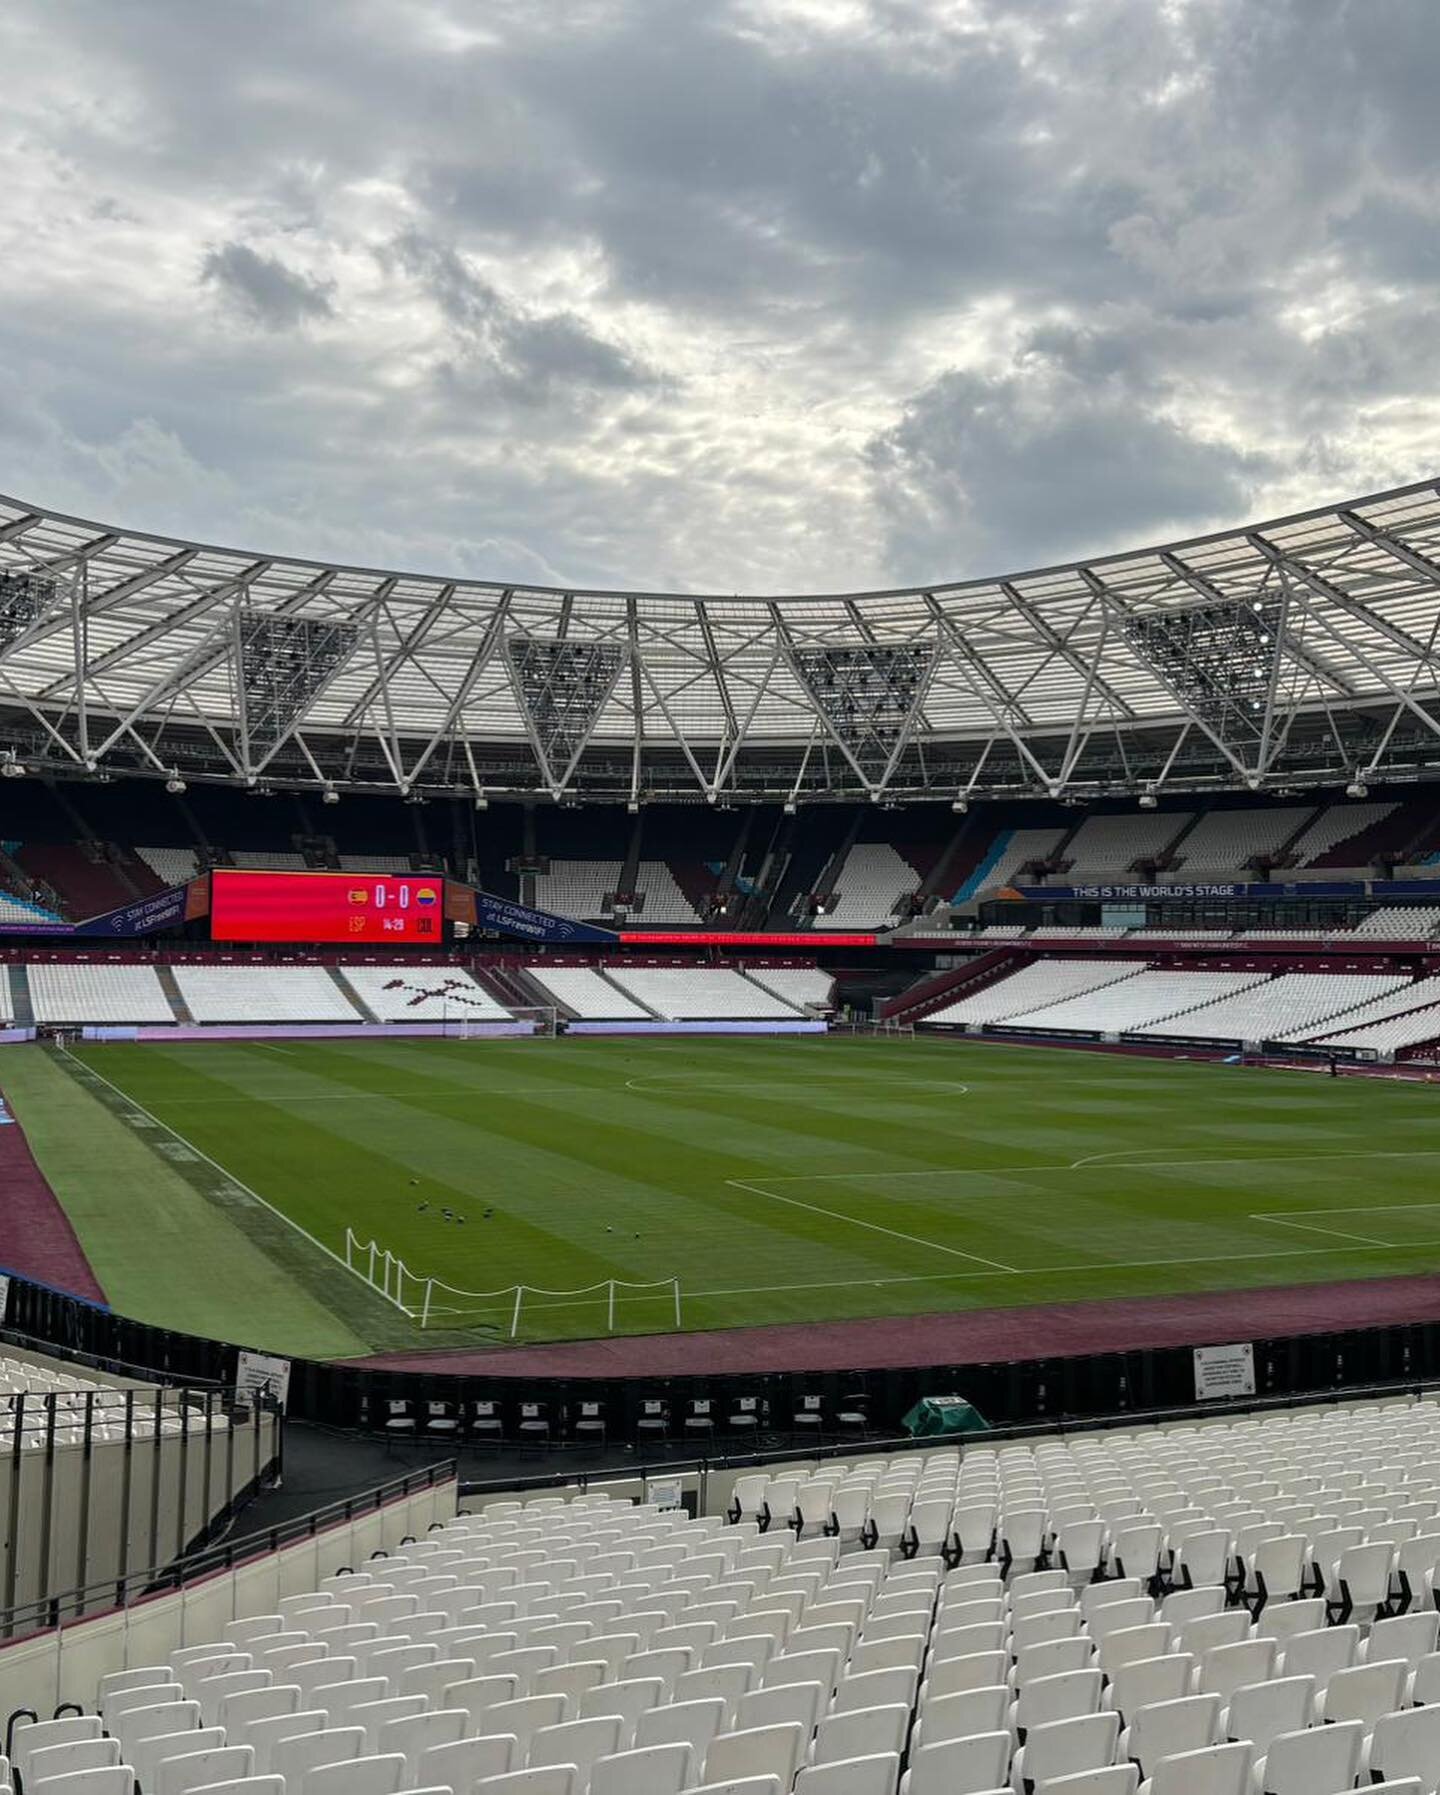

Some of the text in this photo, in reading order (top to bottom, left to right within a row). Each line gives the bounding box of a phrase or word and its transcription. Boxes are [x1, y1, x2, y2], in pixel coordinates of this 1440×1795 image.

[1072, 884, 1235, 897] THIS IS THE WORLD'S STAGE
[126, 906, 143, 921] STAY
[482, 898, 556, 928] STAY CONNECTED
